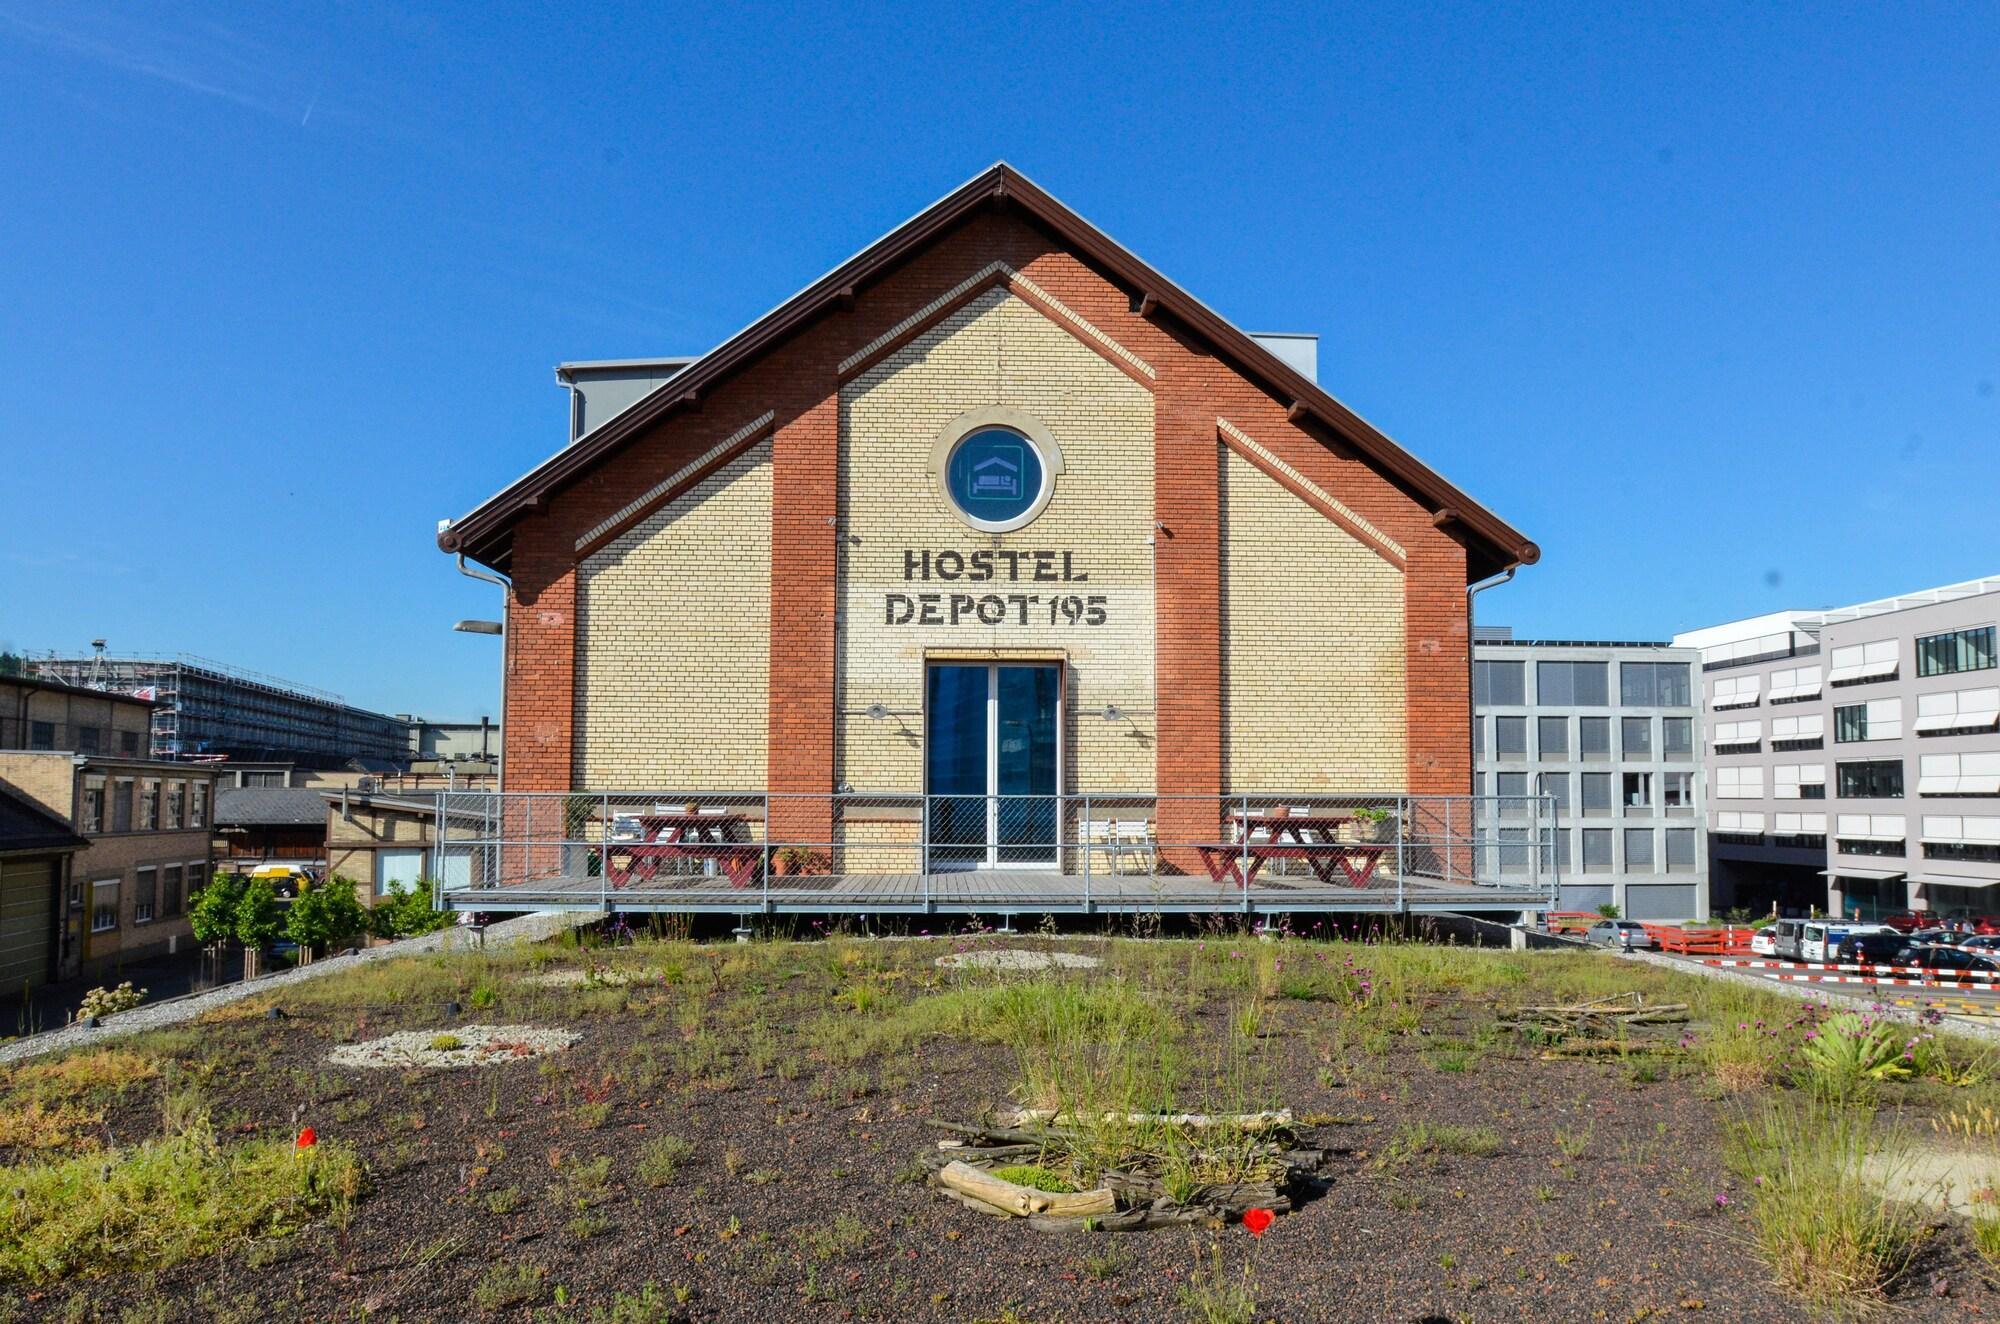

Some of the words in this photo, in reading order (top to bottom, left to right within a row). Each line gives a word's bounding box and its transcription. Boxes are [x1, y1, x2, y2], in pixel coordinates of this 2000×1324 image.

[904, 550, 1088, 581] HOSTEL
[885, 594, 1039, 625] DEPOT
[1048, 595, 1107, 626] 195
